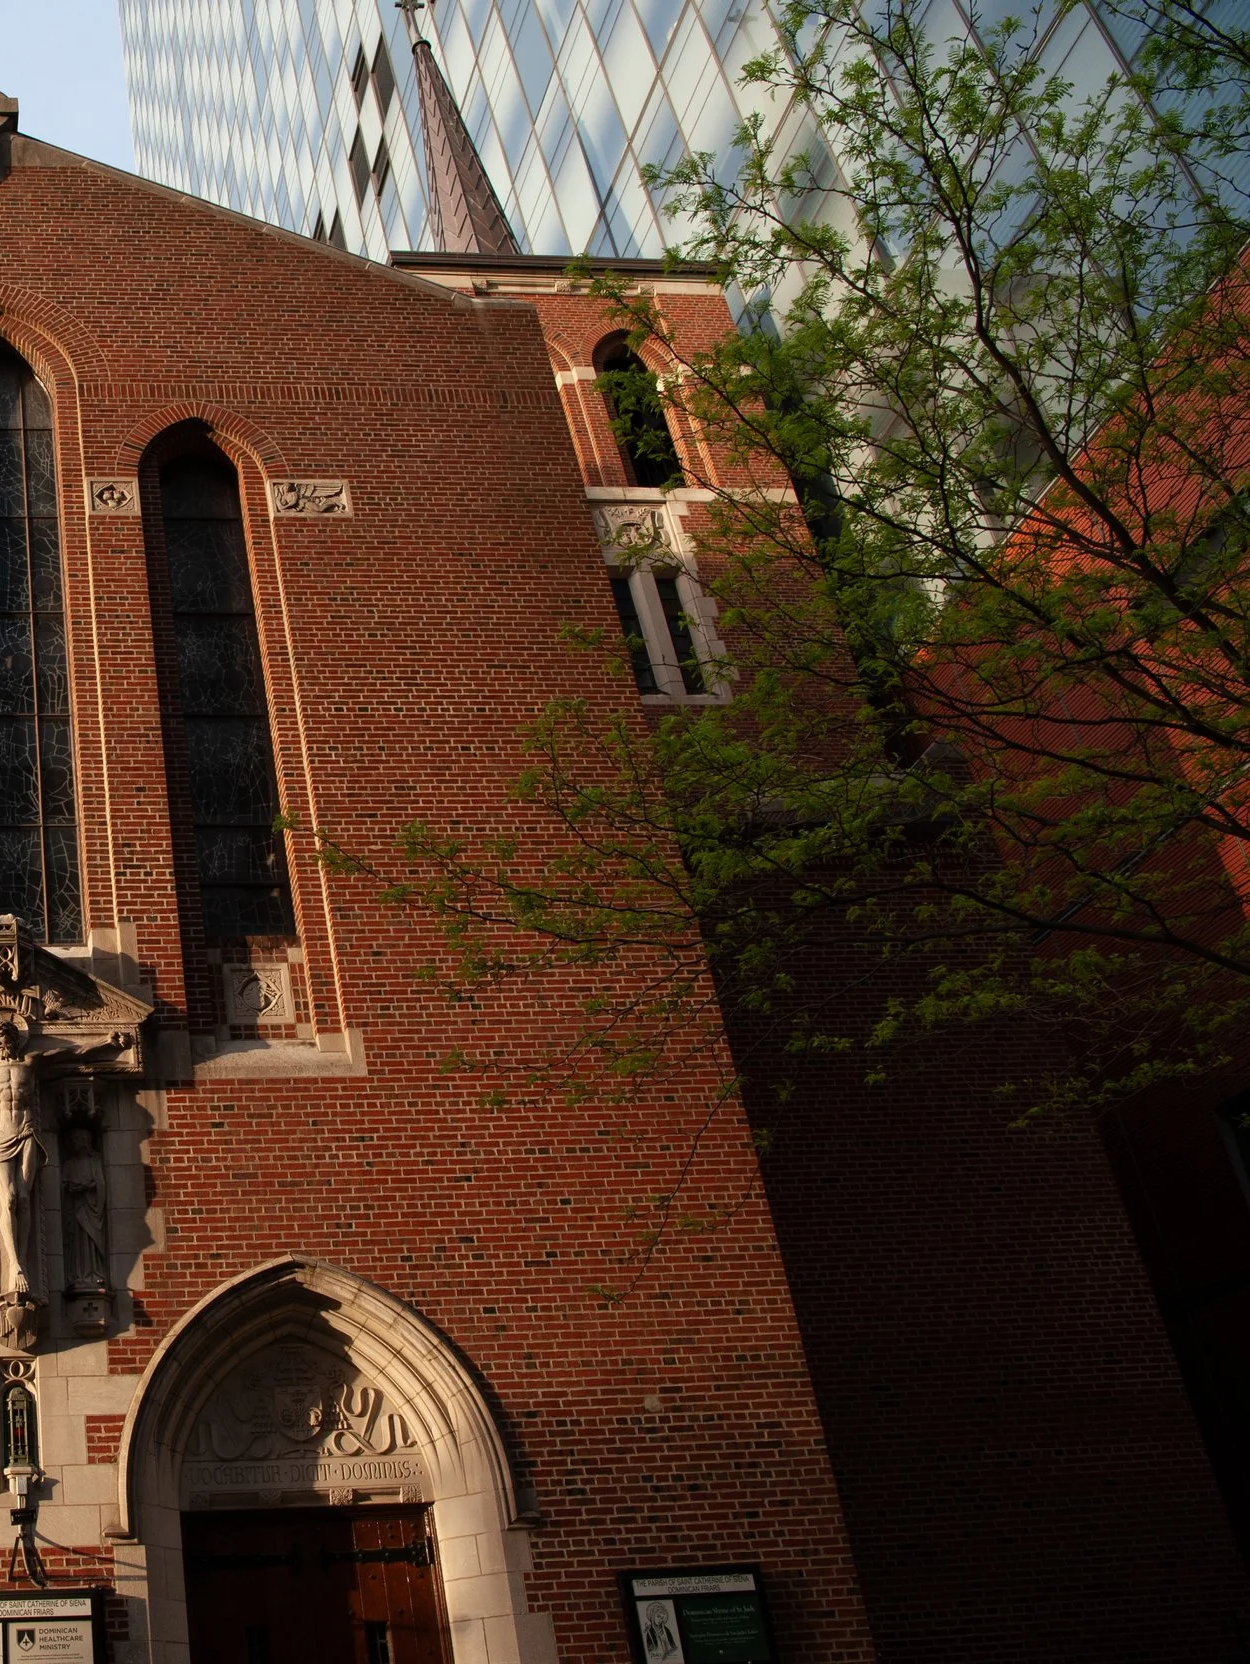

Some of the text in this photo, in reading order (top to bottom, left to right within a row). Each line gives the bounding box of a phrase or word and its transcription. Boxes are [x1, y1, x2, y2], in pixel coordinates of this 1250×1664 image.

[648, 1579, 668, 1587] PARISH
[668, 1585, 700, 1594] DOMINICAN
[0, 1601, 8, 1609] OF
[27, 1600, 59, 1608] CATHERINE
[33, 1608, 54, 1616] FRIARS
